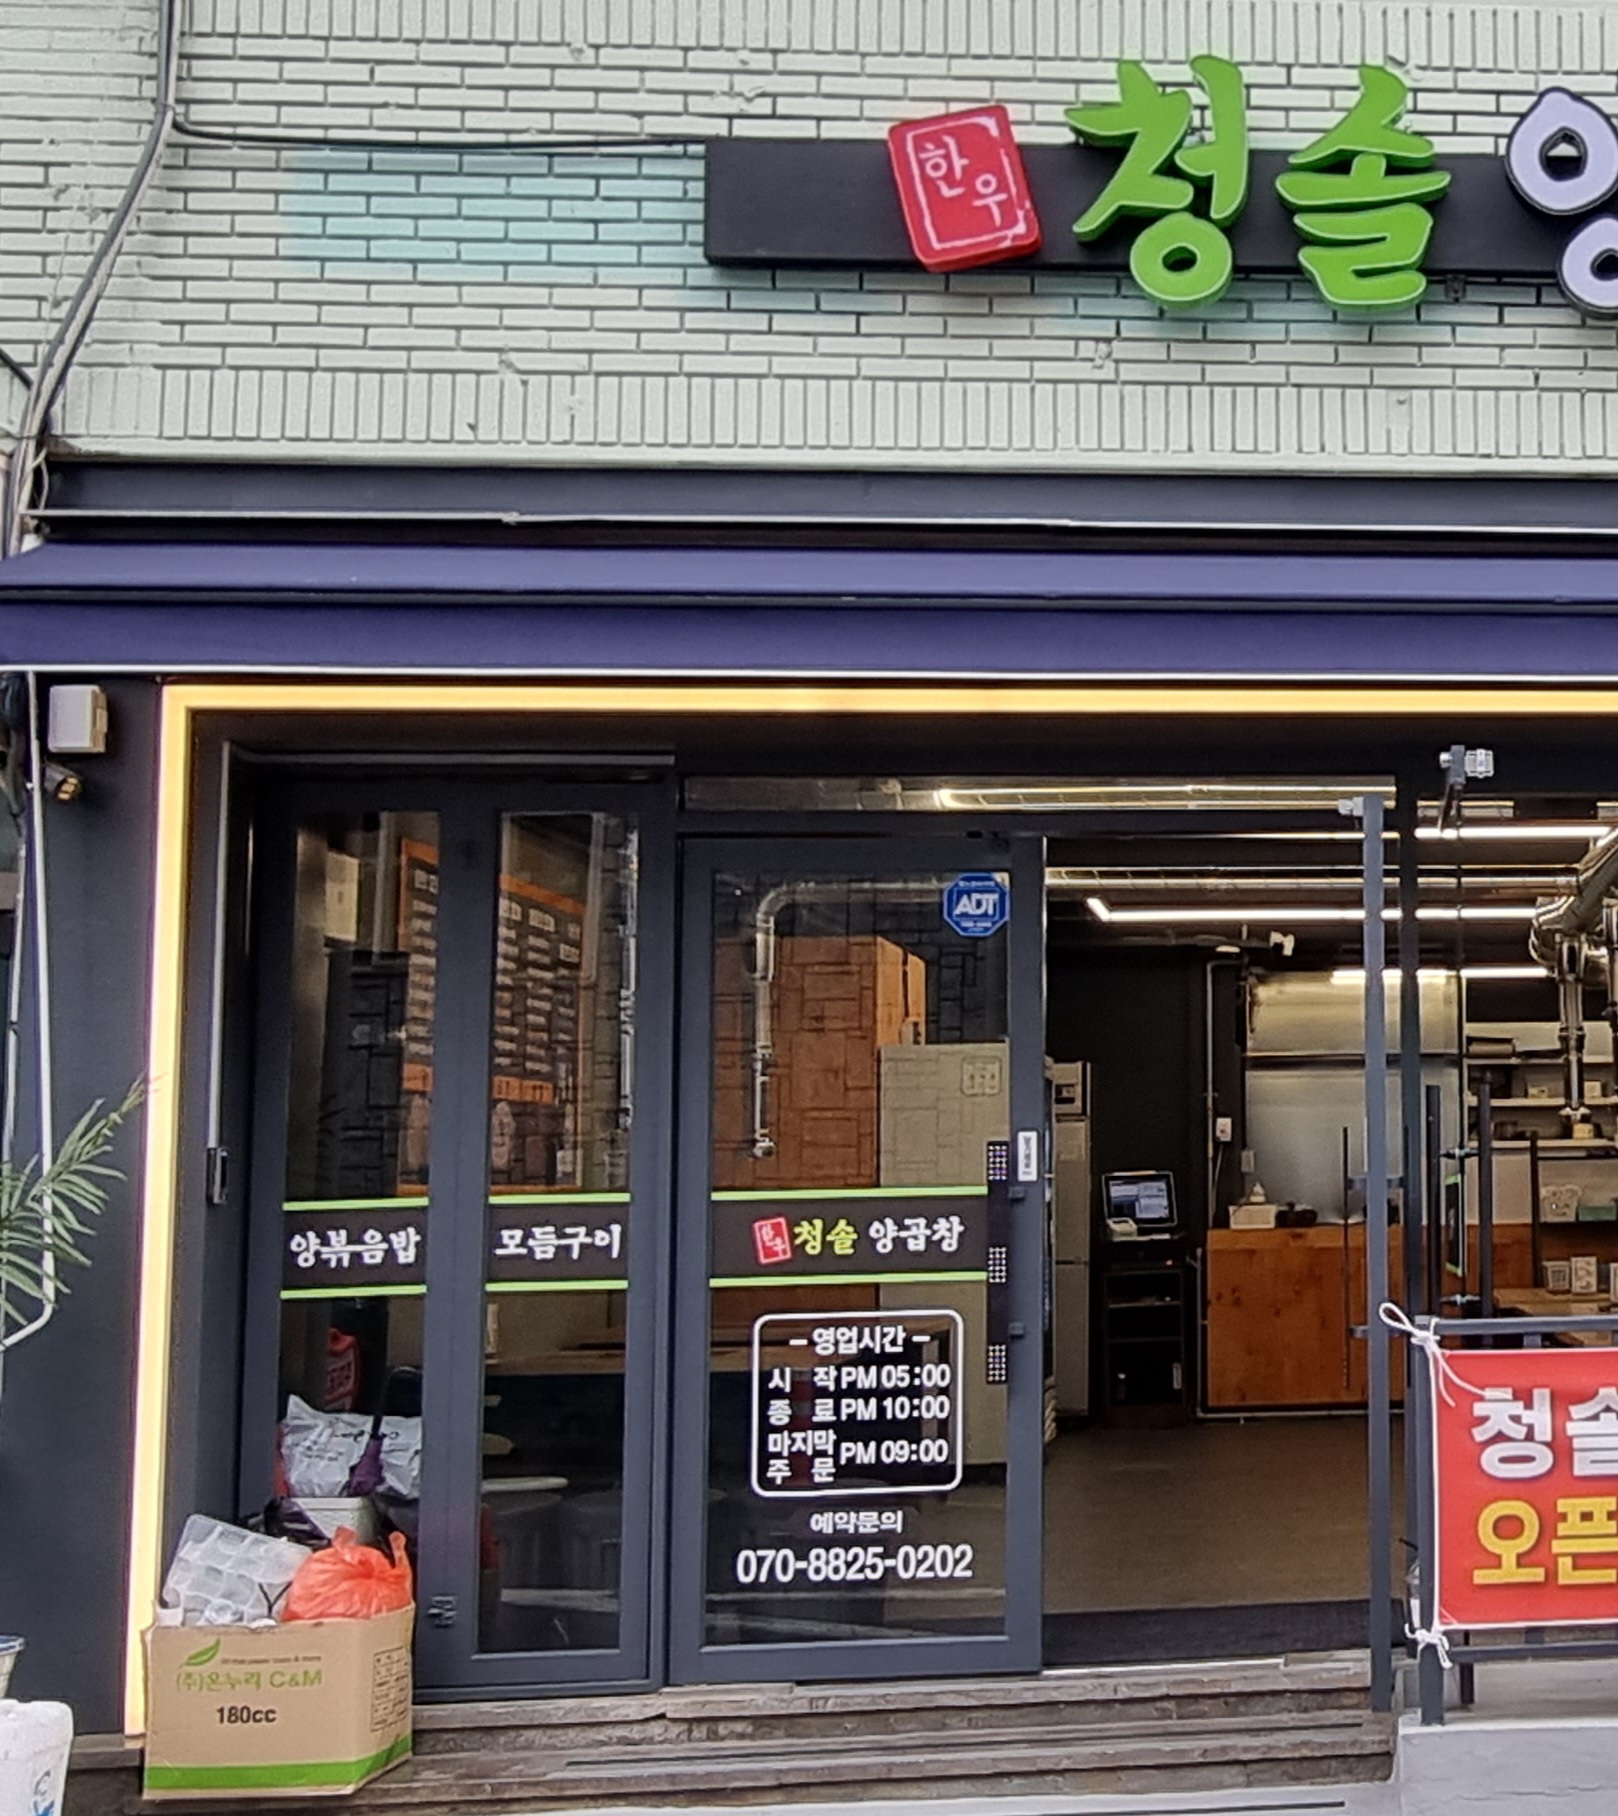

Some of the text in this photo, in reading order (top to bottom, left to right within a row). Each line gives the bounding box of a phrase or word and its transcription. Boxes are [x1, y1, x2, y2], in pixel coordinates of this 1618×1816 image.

[918, 141, 1010, 226] 한우
[1063, 53, 1452, 310] 청솔
[953, 892, 999, 916] ADT
[289, 1226, 422, 1269] 양볶음밥
[493, 1223, 622, 1260] 모듬구이
[793, 1218, 859, 1256] 청솔
[868, 1215, 965, 1254] 양곱창
[811, 1326, 906, 1354] 영업시간
[840, 1366, 878, 1390] PM
[881, 1363, 952, 1388] 05:00
[840, 1398, 877, 1422] PM
[882, 1395, 951, 1420] 10:00
[767, 1430, 837, 1457] 마지막
[840, 1439, 949, 1466] PM 09:00
[810, 1510, 904, 1535] 예약문의
[736, 1543, 974, 1584] 070-8825-0202
[268, 1668, 323, 1689] C&M
[216, 1704, 278, 1725] 180cc
